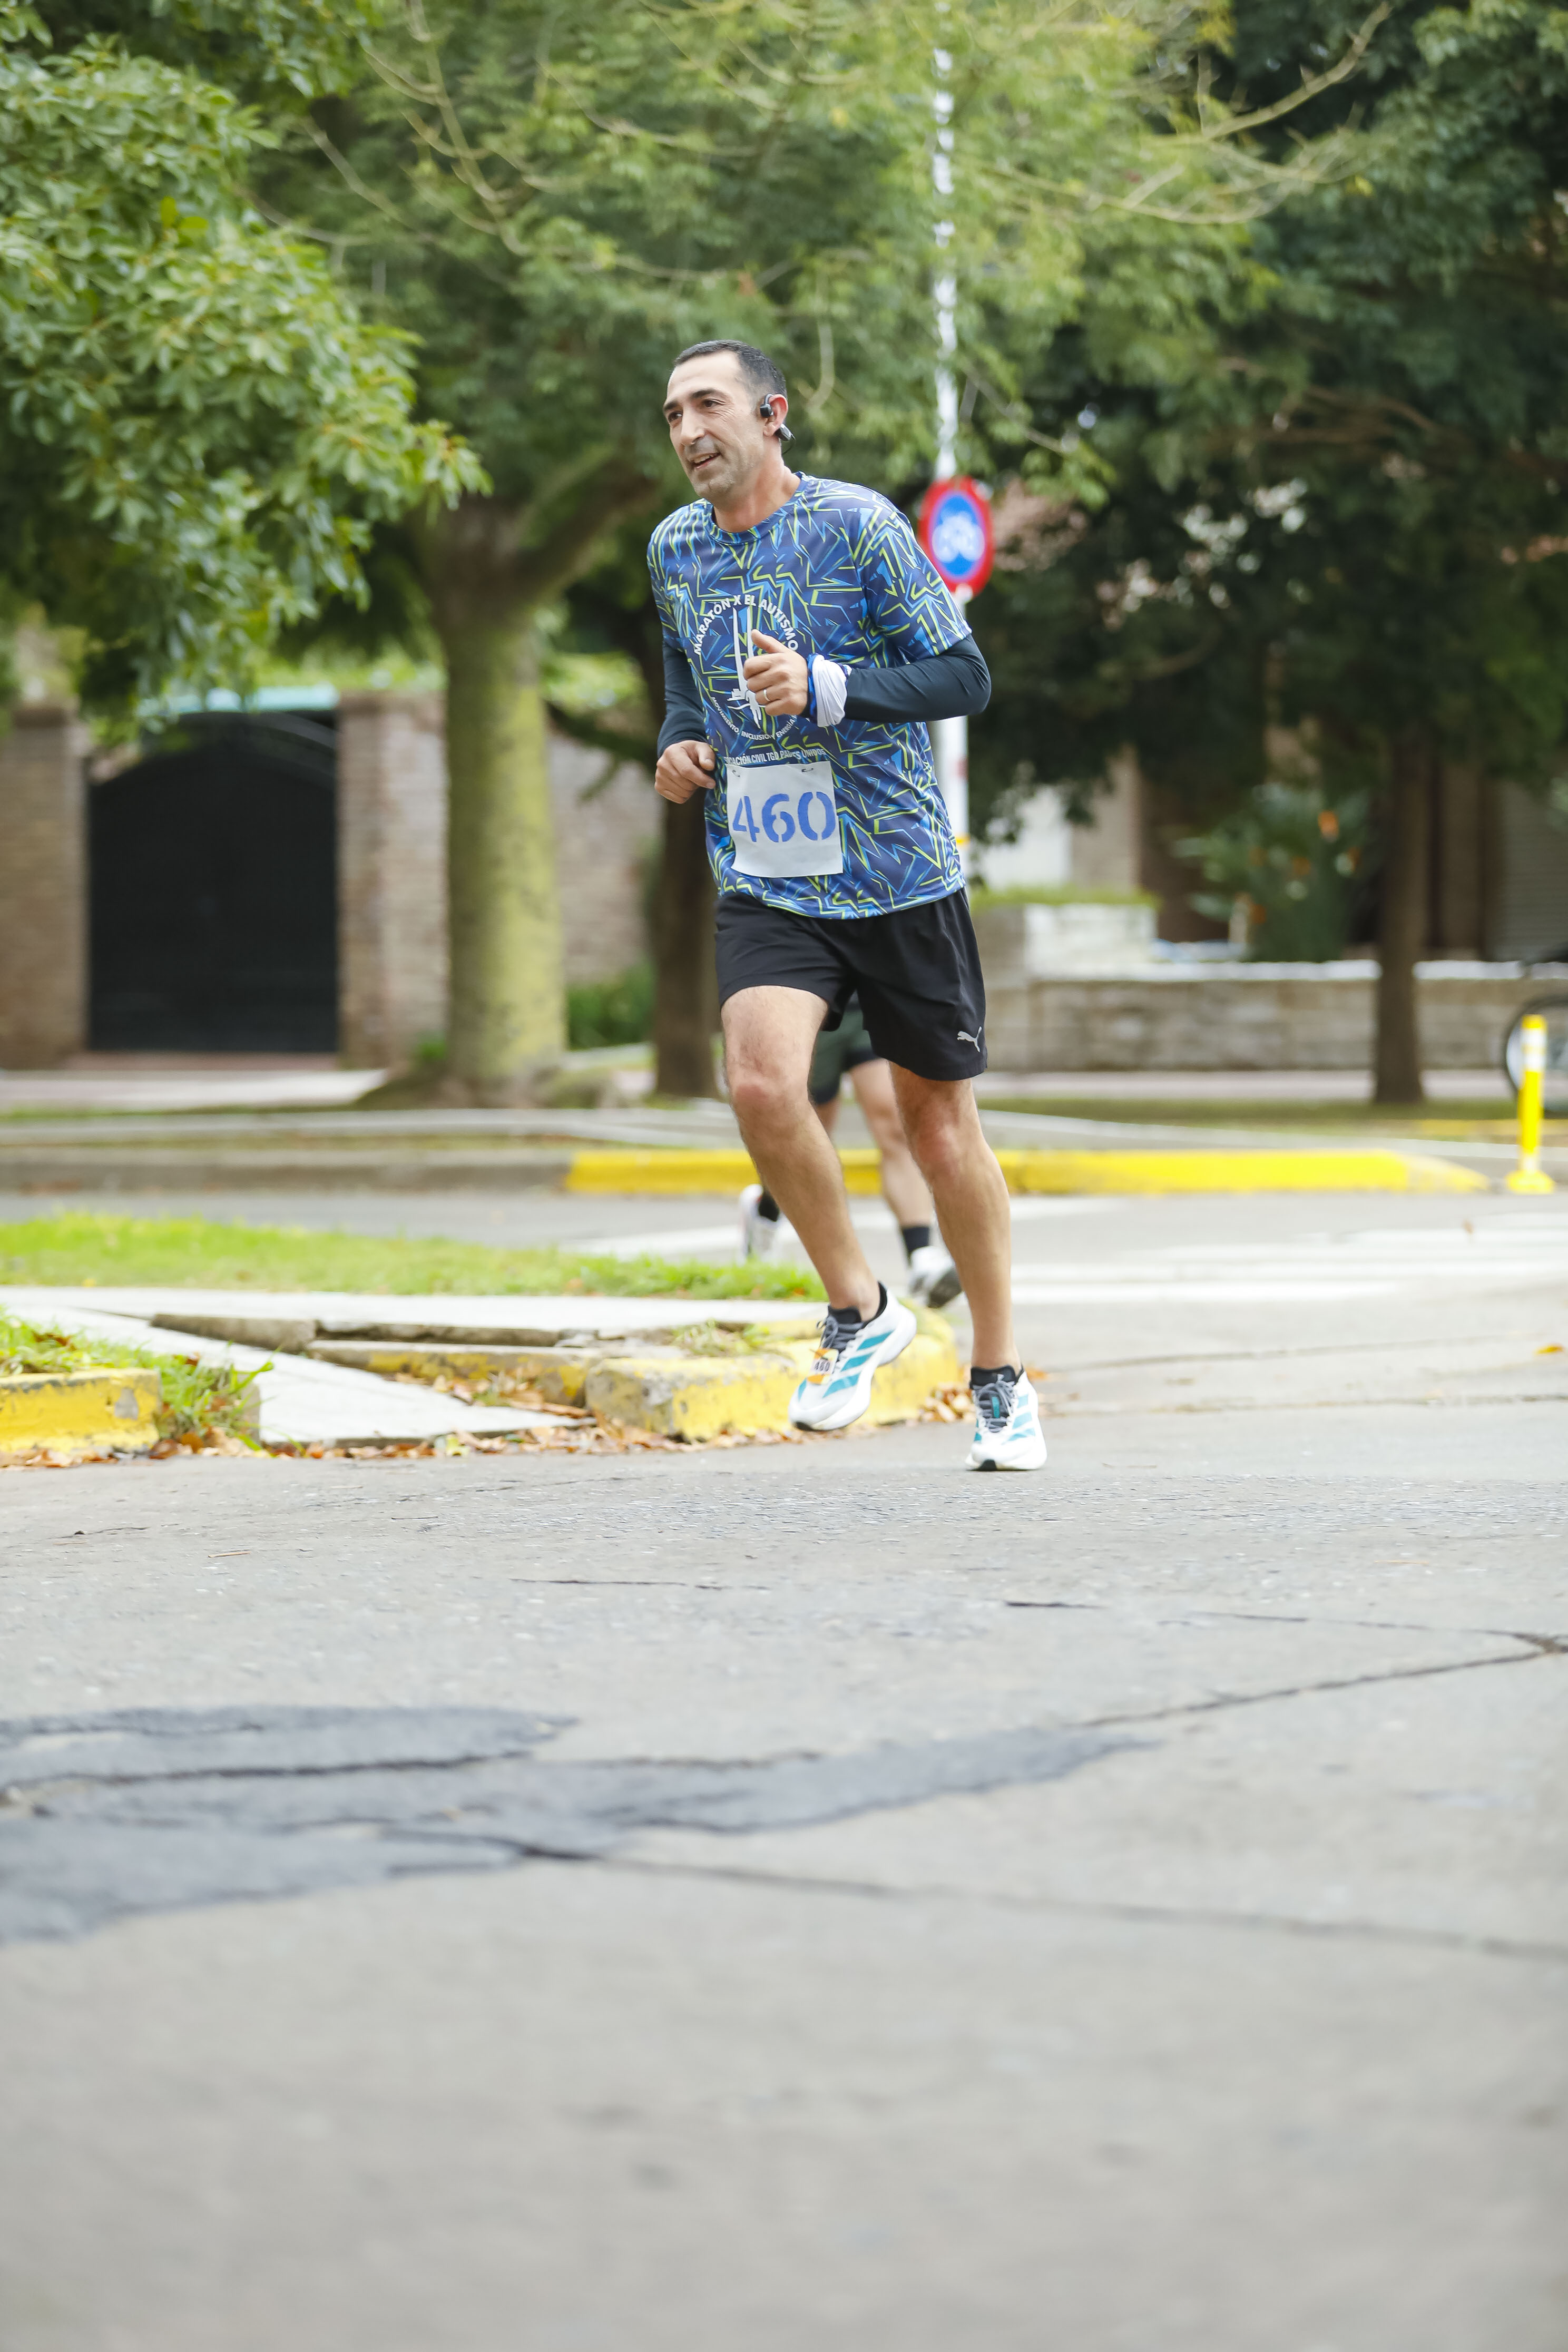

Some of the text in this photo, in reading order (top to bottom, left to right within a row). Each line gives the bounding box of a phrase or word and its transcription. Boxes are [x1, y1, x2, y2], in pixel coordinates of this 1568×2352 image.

[694, 594, 799, 655] MARATÓN X EL AUTISMO
[767, 751, 779, 761] TGD
[732, 791, 836, 842] 460
[814, 1361, 830, 1371] 460
